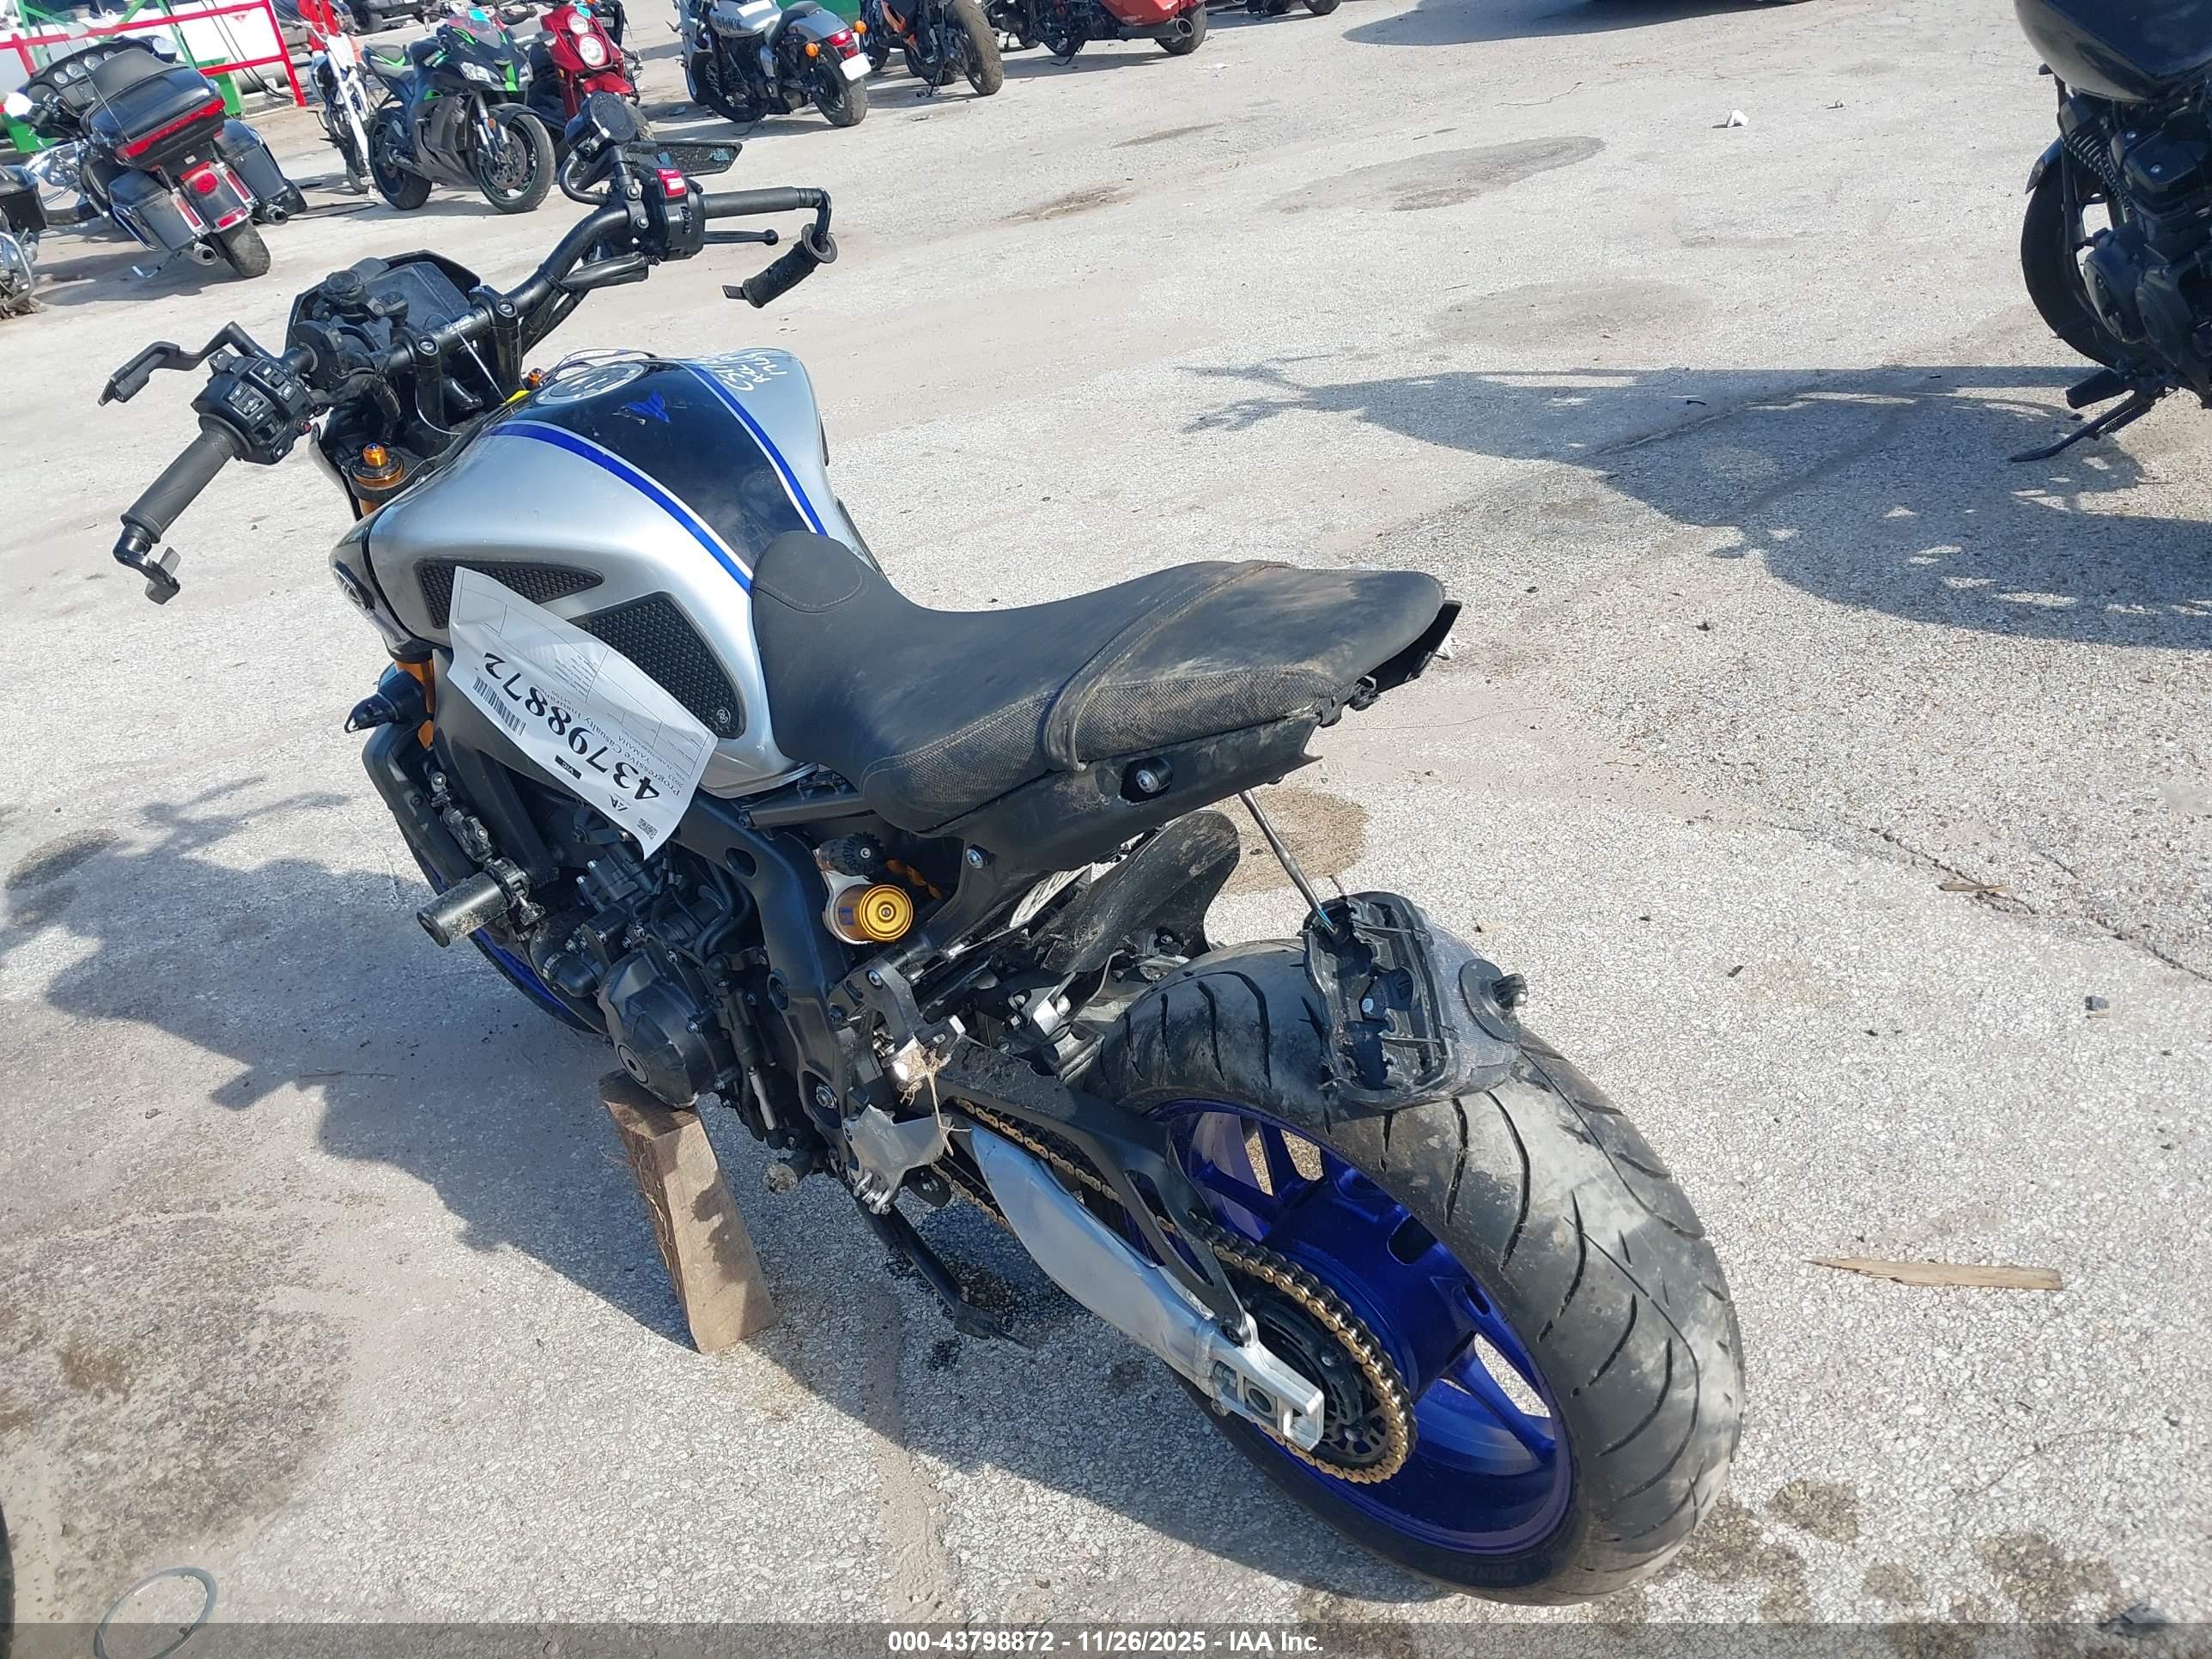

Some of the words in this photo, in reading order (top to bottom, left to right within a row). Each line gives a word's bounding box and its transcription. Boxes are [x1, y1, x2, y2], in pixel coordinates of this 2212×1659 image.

[483, 652, 660, 800] 43798872
[581, 715, 624, 756] Casualty
[561, 762, 575, 774] VIC
[616, 734, 652, 764] YAMAHA
[623, 750, 682, 797] Progressive
